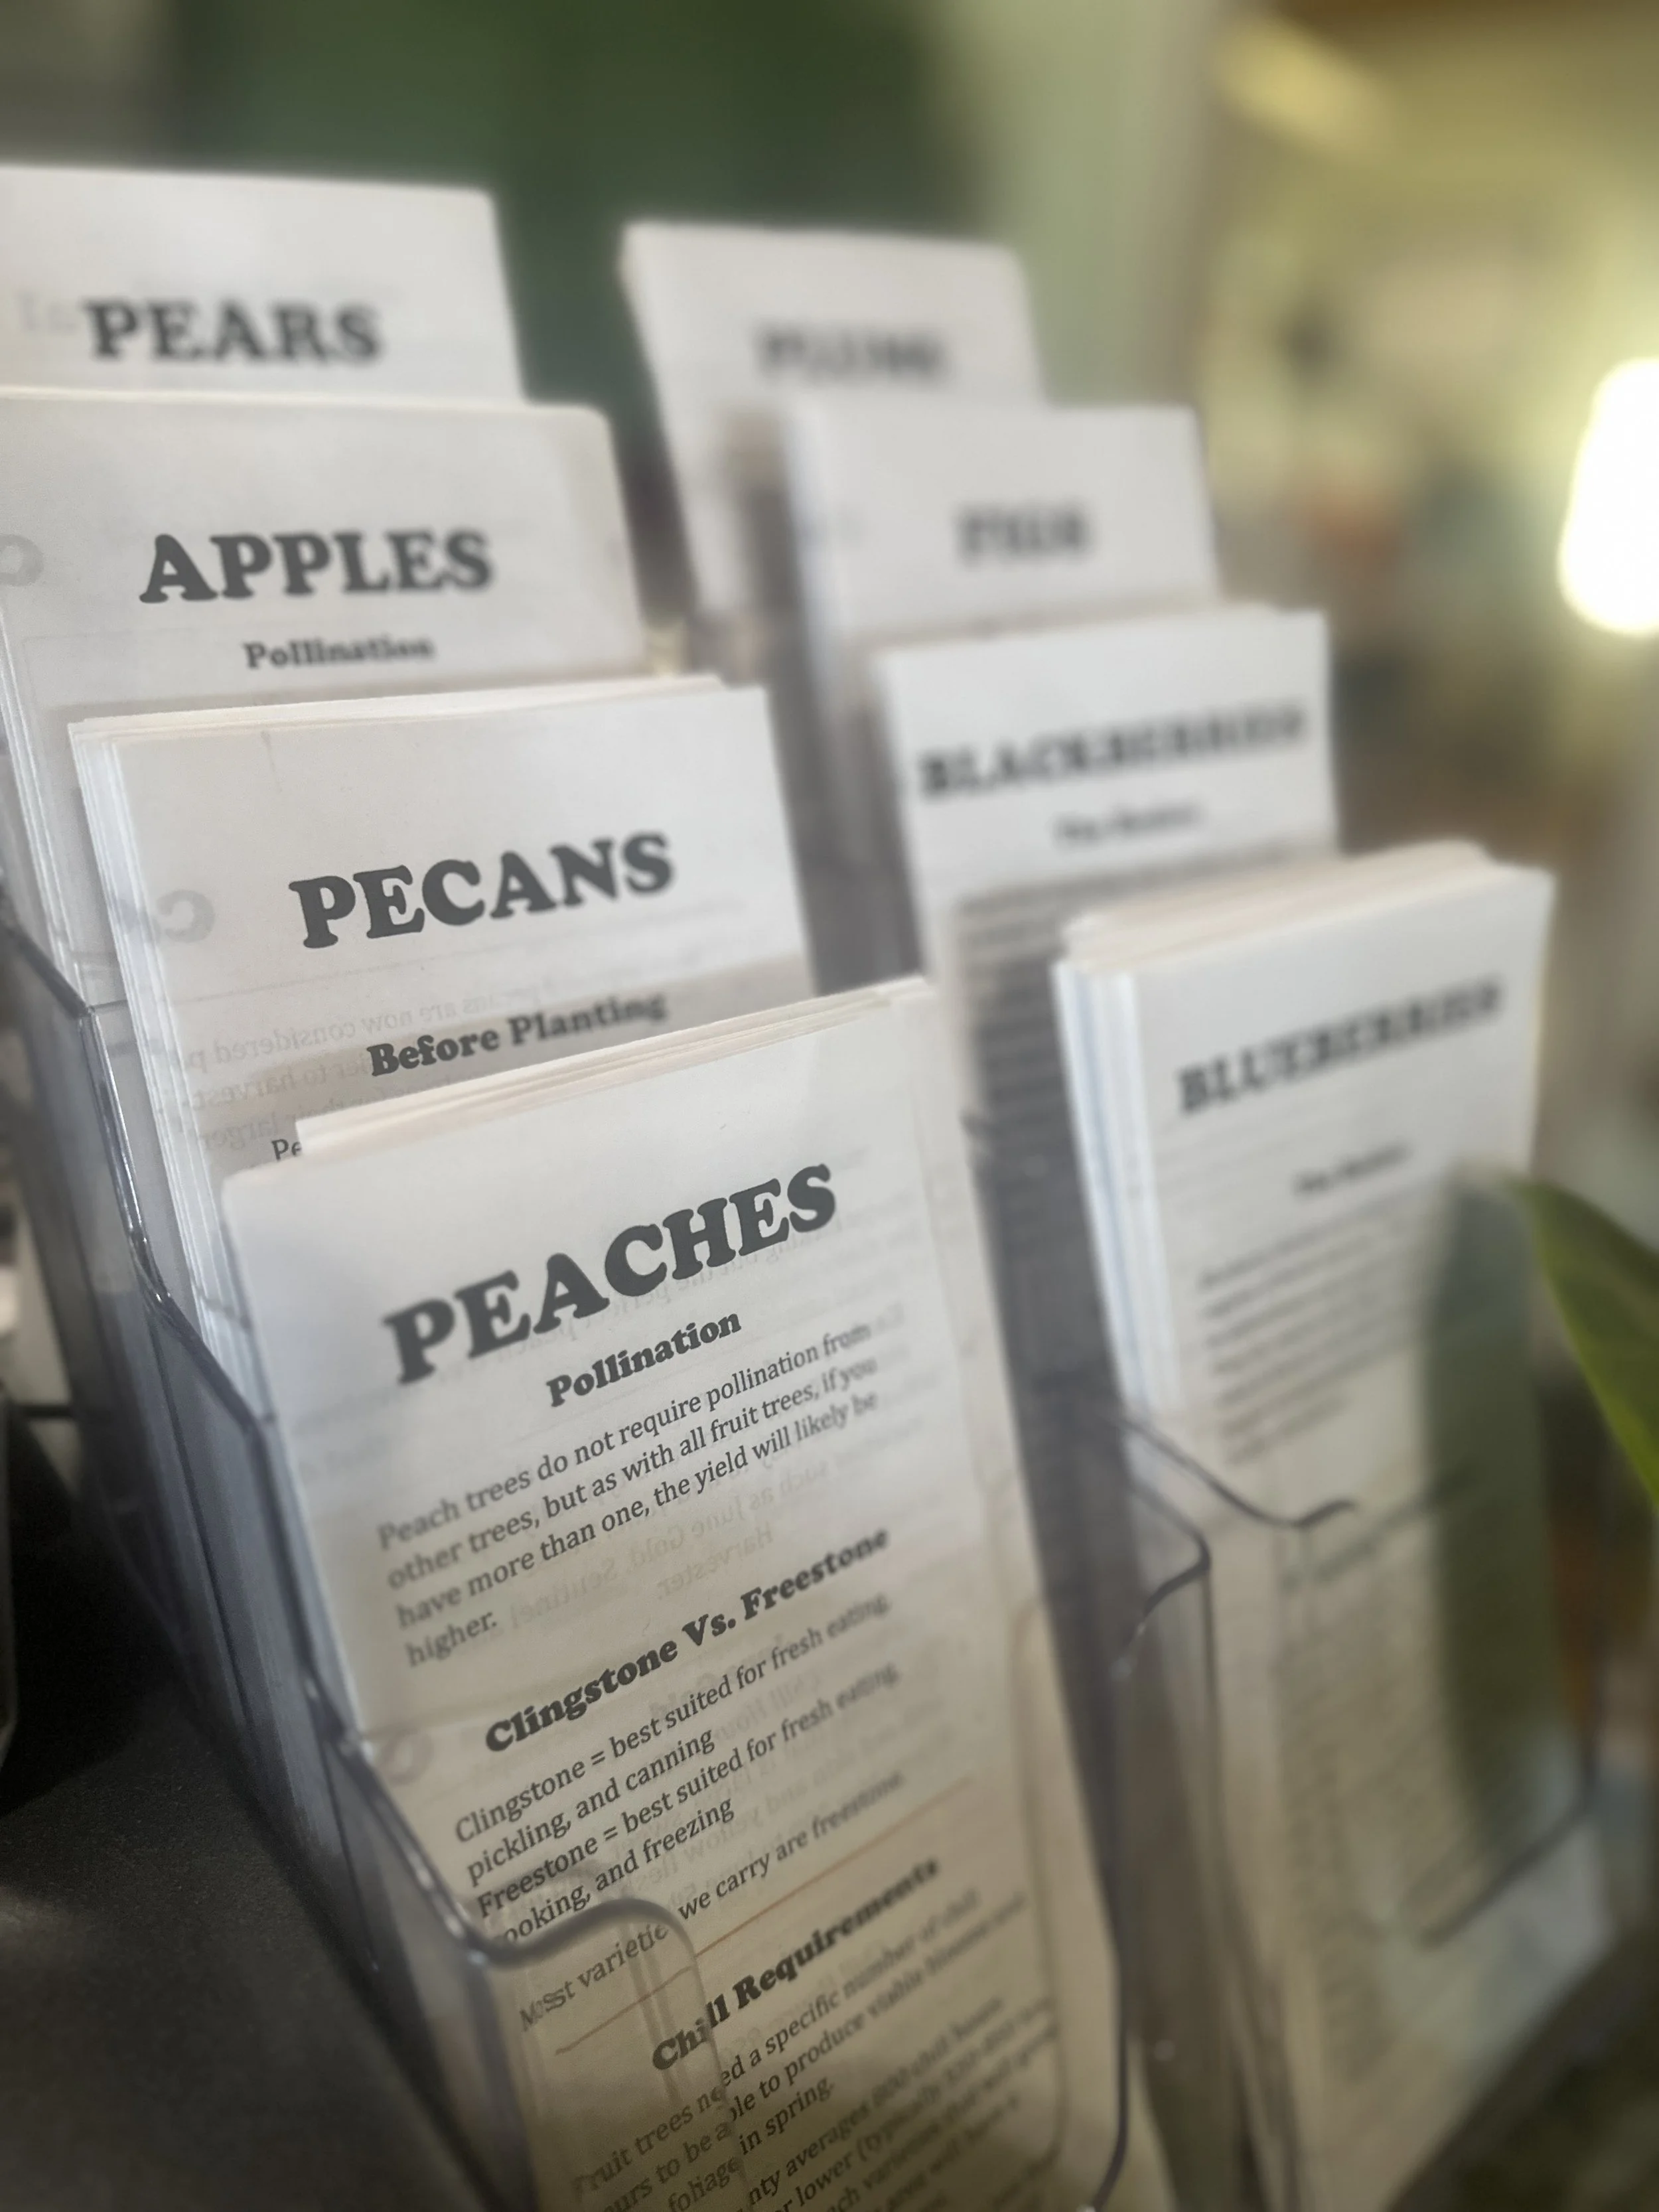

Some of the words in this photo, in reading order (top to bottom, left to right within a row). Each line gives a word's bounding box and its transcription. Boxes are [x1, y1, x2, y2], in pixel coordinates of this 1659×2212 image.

[82, 296, 384, 365] PEARS
[139, 529, 495, 605] APPLES
[243, 634, 437, 670] Pollination
[287, 831, 676, 950] PECANS
[366, 1033, 500, 1077] Before
[507, 992, 672, 1047] Planting
[381, 1163, 837, 1384] PEACHES
[376, 1499, 461, 1552] Peach
[465, 1470, 532, 1512] trees
[537, 1454, 569, 1480] do
[574, 1432, 615, 1465] not
[618, 1396, 702, 1441] require
[707, 1345, 820, 1412] pollination
[822, 1323, 873, 1358] from
[545, 1311, 742, 1408] Pollination
[387, 1542, 463, 1591] other
[467, 1511, 540, 1554] trees,
[541, 1483, 589, 1519] but
[591, 1472, 617, 1497] as
[621, 1443, 675, 1483] with
[679, 1430, 707, 1457] all
[709, 1406, 760, 1443] fruit
[761, 1382, 821, 1420] trees,
[821, 1366, 840, 1393] if
[395, 1586, 463, 1631] have
[467, 1552, 535, 1596] more
[539, 1524, 597, 1562] than
[601, 1499, 651, 1532] one,
[652, 1476, 691, 1507] the
[695, 1444, 749, 1495] yield
[751, 1424, 792, 1461] will
[795, 1402, 850, 1443] likely
[851, 1390, 880, 1418] be
[404, 1611, 498, 1668] higher.
[485, 1637, 678, 1753] Clingstone
[682, 1613, 737, 1647] Vs.
[741, 1528, 891, 1621] Freestone
[455, 1760, 587, 1843] Clingstone
[590, 1749, 606, 1768] =
[609, 1717, 662, 1758] best
[664, 1676, 733, 1727] suited
[735, 1658, 767, 1691] for
[771, 1626, 825, 1670] fresh
[467, 1811, 572, 1887] pickling,
[575, 1776, 622, 1820] and
[625, 1729, 716, 1793] canning
[476, 1837, 599, 1919] Freestone
[603, 1825, 619, 1842] =
[620, 1792, 674, 1834] best
[676, 1747, 744, 1806] suited
[745, 1731, 778, 1763] for
[780, 1696, 835, 1743] fresh
[502, 1885, 592, 1945] ooking,
[595, 1850, 640, 1891] and
[642, 1798, 735, 1864] freezing
[576, 1923, 669, 1988] varietie
[677, 1891, 711, 1921] we
[715, 1850, 771, 1899] carry
[775, 1832, 809, 1864] are
[652, 1993, 731, 2071] Chill
[732, 1854, 944, 2012] Requirements
[633, 2104, 695, 2156] trees
[695, 2055, 746, 2114] need
[749, 2047, 763, 2067] a
[764, 1987, 841, 2056] specific
[654, 2158, 682, 2183] to
[682, 2133, 711, 2164] be
[759, 2074, 780, 2100] to
[784, 2010, 865, 2085] produce
[738, 2130, 764, 2156] in
[796, 2151, 855, 2208] lower
